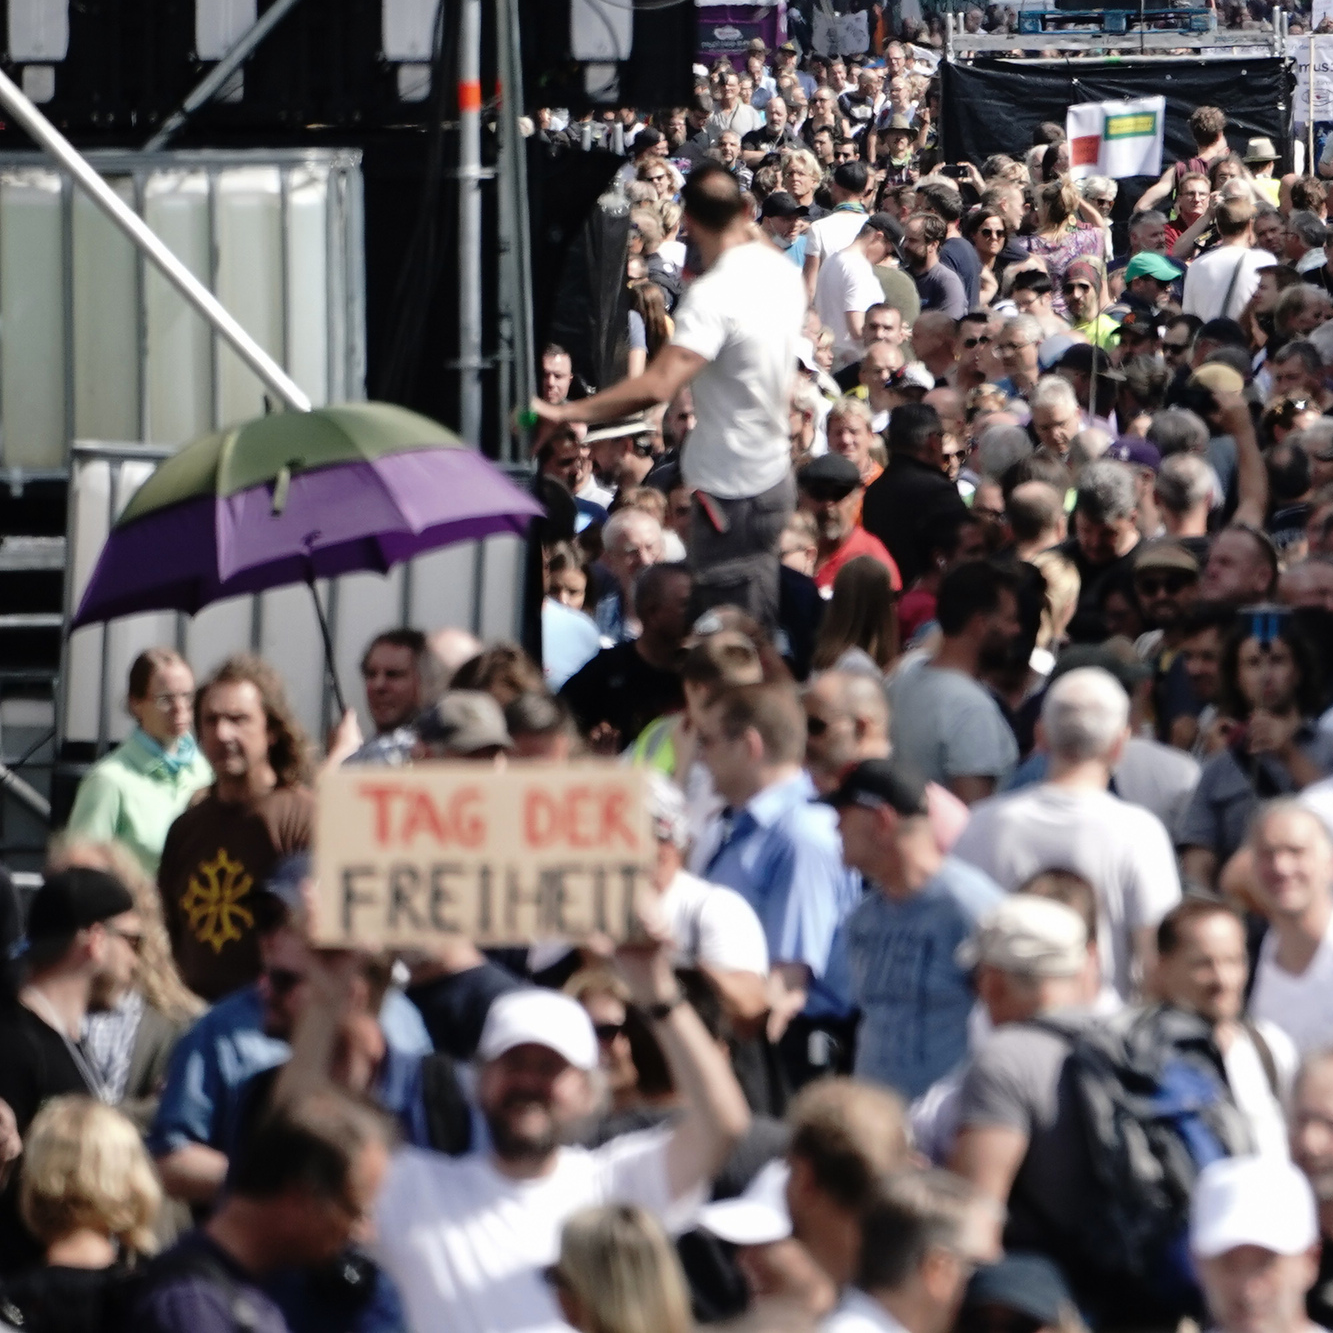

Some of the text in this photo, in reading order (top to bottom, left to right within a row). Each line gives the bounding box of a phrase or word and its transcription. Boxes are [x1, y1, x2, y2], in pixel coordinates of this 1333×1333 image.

[359, 784, 638, 852] TAG DER
[340, 862, 646, 936] FREIHEIT
